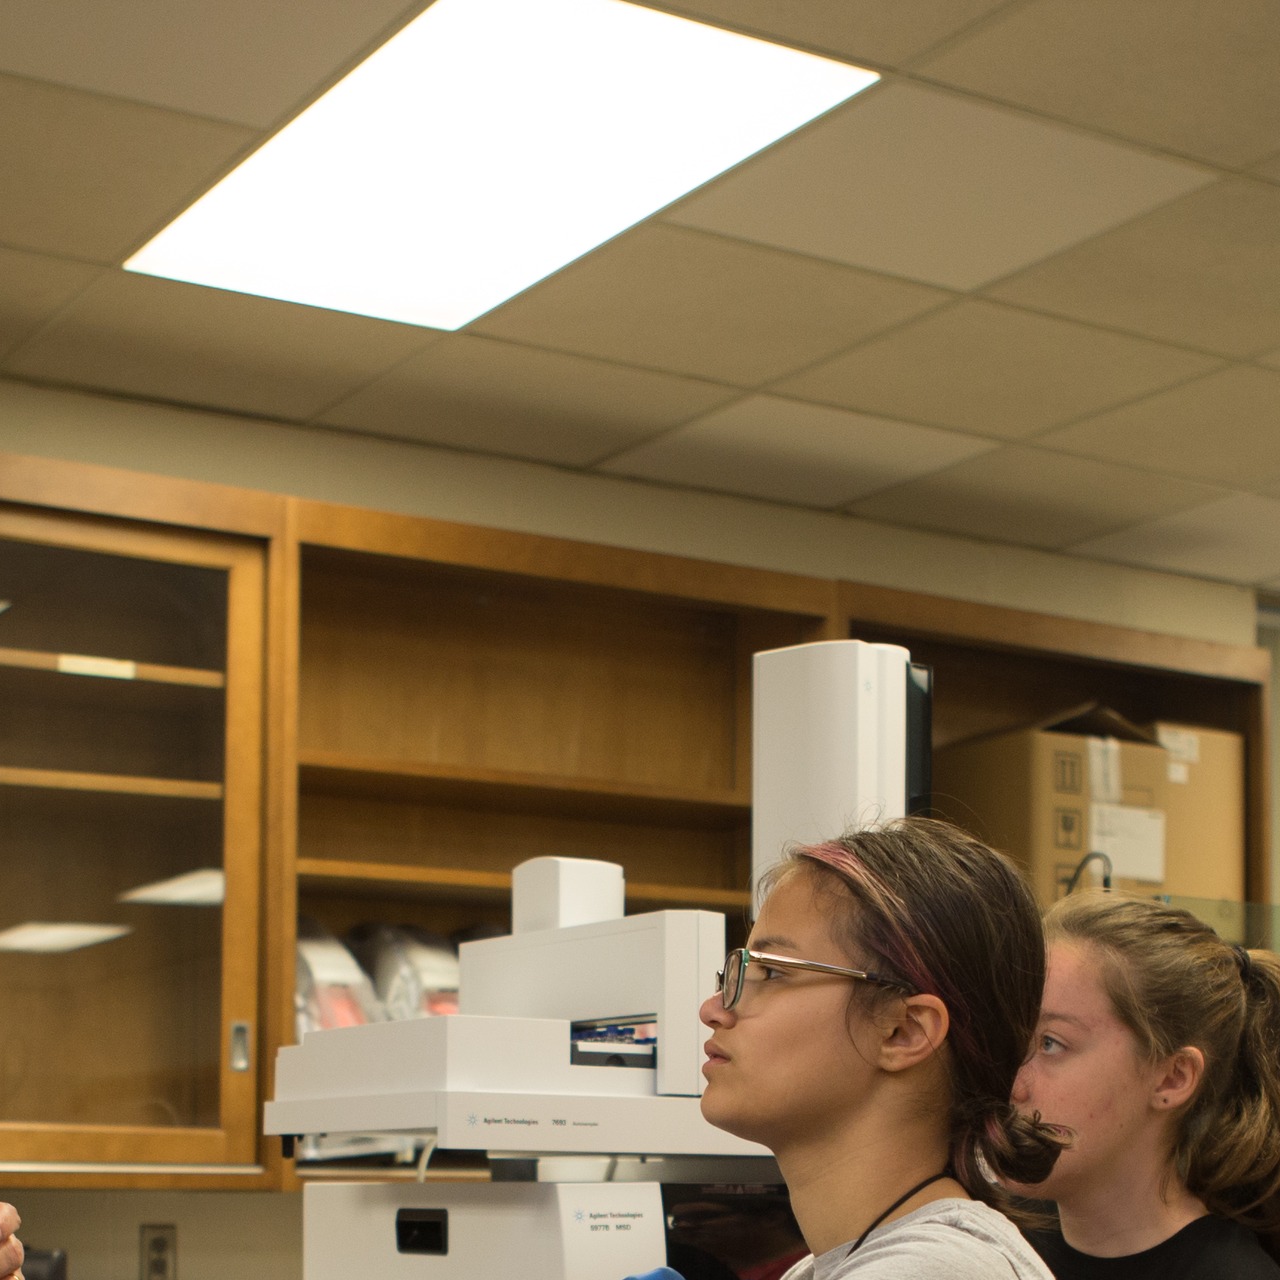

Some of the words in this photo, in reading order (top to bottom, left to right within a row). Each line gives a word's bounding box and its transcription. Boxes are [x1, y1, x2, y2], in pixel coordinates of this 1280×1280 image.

[483, 1117, 503, 1125] Agilent
[504, 1117, 539, 1126] Technologies
[589, 1212, 608, 1220] Agilent
[609, 1212, 644, 1220] Technologies
[615, 1223, 632, 1231] MSD
